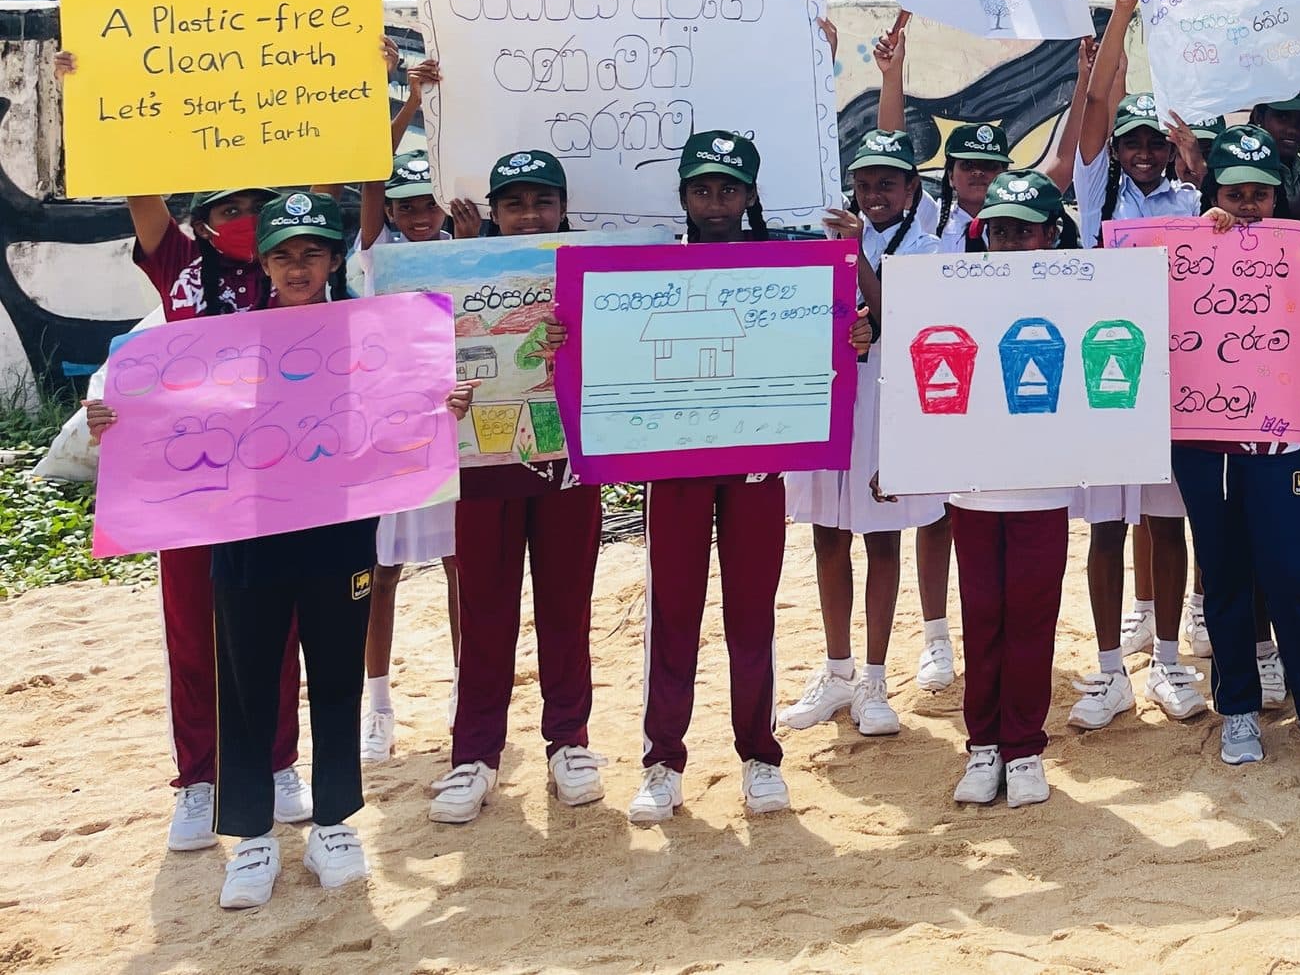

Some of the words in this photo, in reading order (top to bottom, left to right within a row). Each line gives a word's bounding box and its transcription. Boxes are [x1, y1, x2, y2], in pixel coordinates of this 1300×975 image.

[101, 8, 132, 38] A
[143, 45, 244, 75] Clean
[261, 42, 337, 68] Earth
[99, 91, 162, 122] Let's
[295, 81, 373, 106] Protect
[192, 126, 247, 151] The
[261, 121, 321, 146] Earth
[941, 258, 1011, 278] පරිසරය
[1031, 258, 1096, 281] සුරකිමු
[463, 285, 553, 312] පරිසරය
[1194, 284, 1273, 315] රටක්
